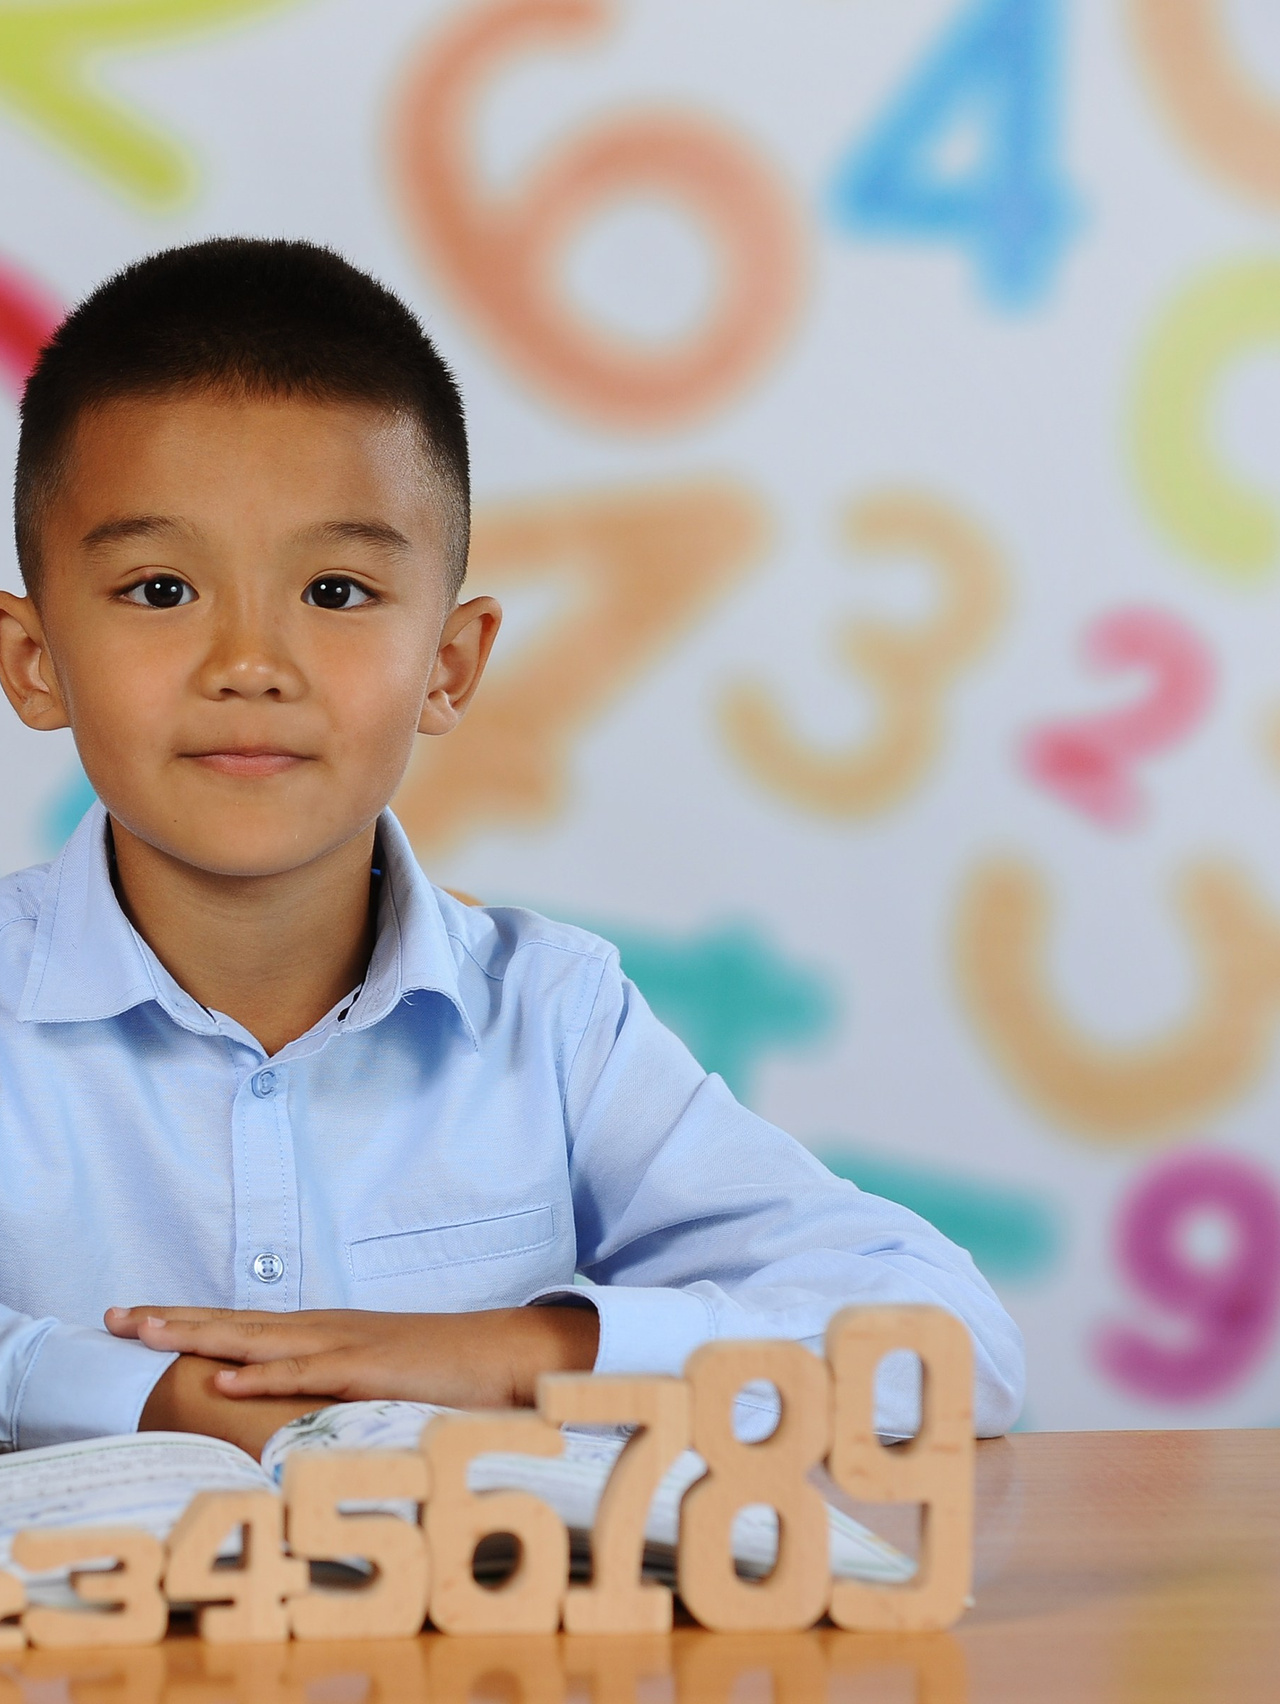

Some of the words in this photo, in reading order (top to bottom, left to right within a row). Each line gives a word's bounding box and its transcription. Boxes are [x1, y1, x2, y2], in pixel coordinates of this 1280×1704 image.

[385, 0, 812, 435] 6
[828, 0, 1082, 312] 4
[715, 485, 1012, 822] 3
[1017, 603, 1220, 833] 2
[1090, 1145, 1280, 1412] 9
